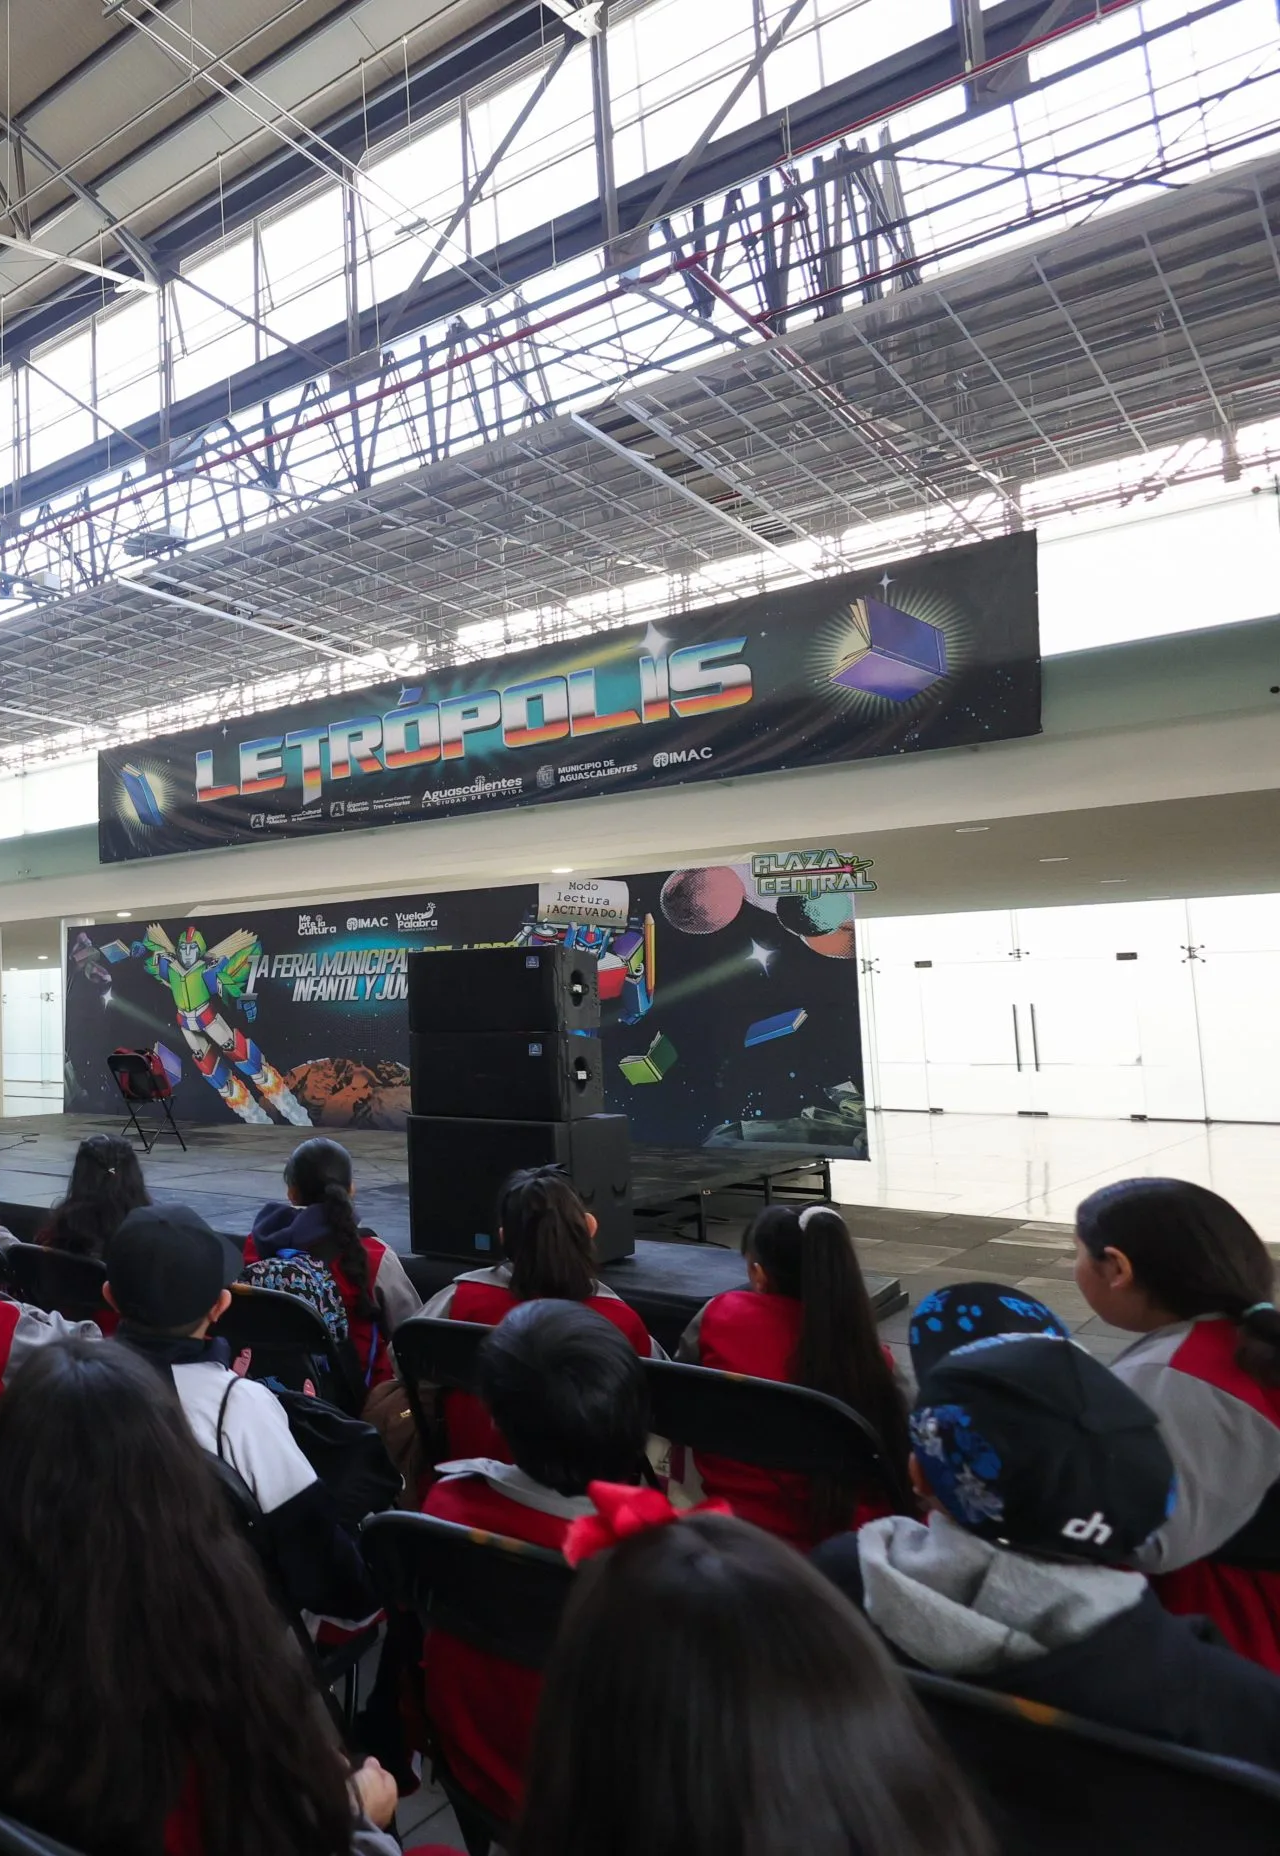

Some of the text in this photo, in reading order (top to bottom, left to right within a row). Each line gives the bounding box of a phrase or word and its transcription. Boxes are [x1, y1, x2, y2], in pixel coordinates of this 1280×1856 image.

[670, 747, 713, 764] IMAC
[558, 759, 615, 774] MUNICIPIO DE
[559, 764, 638, 783] AGUASCALIENTES
[422, 776, 522, 801] Aguascalientes
[436, 797, 467, 806] CIUDAD
[501, 788, 523, 797] VIDA
[753, 850, 842, 874] PLAZA
[568, 881, 598, 891] Modo
[557, 892, 610, 905] lectura
[299, 914, 311, 922] Me
[395, 912, 424, 921] Vuela
[546, 904, 623, 919] ¡ACTIVADO!
[298, 925, 337, 936] Cultura
[358, 917, 389, 929] IMAC
[398, 919, 438, 928] Palabra
[271, 952, 317, 978] FERIA
[320, 948, 410, 976] MUNICIPA
[292, 975, 359, 1001] INFANTIL
[362, 974, 378, 1000] Y
